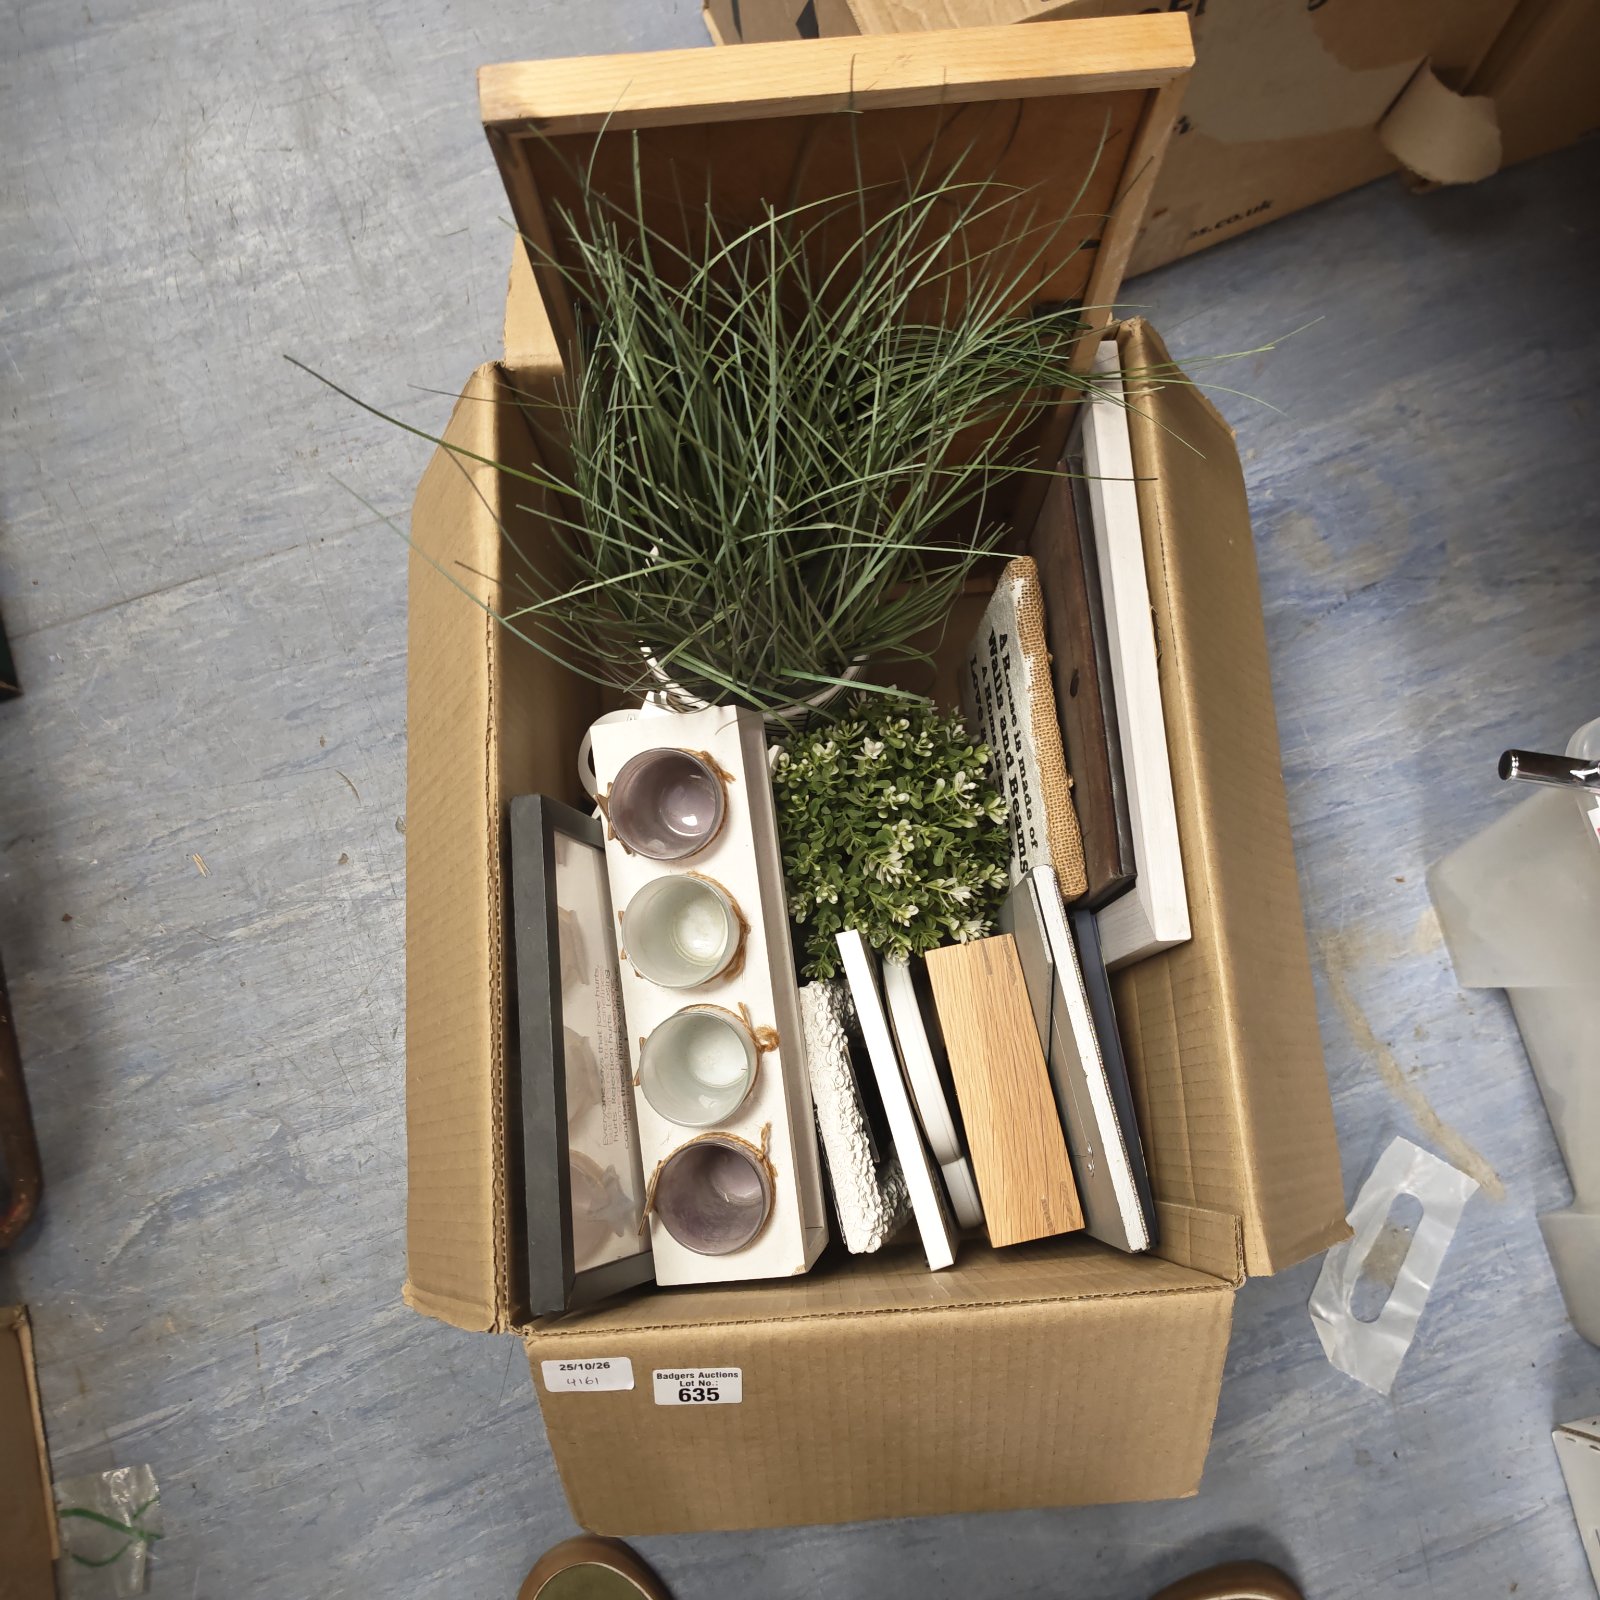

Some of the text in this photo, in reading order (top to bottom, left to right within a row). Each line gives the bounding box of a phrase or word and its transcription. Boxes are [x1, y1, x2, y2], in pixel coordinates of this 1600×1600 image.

[982, 666, 988, 682] A
[970, 652, 984, 722] Love
[984, 682, 996, 748] Home
[988, 626, 1028, 874] Walls and Beams
[999, 634, 1038, 848] A House is made of
[994, 750, 1000, 770] is
[560, 1362, 610, 1370] 25/10/26
[567, 1377, 599, 1386] 4161
[678, 1388, 720, 1402] 635
